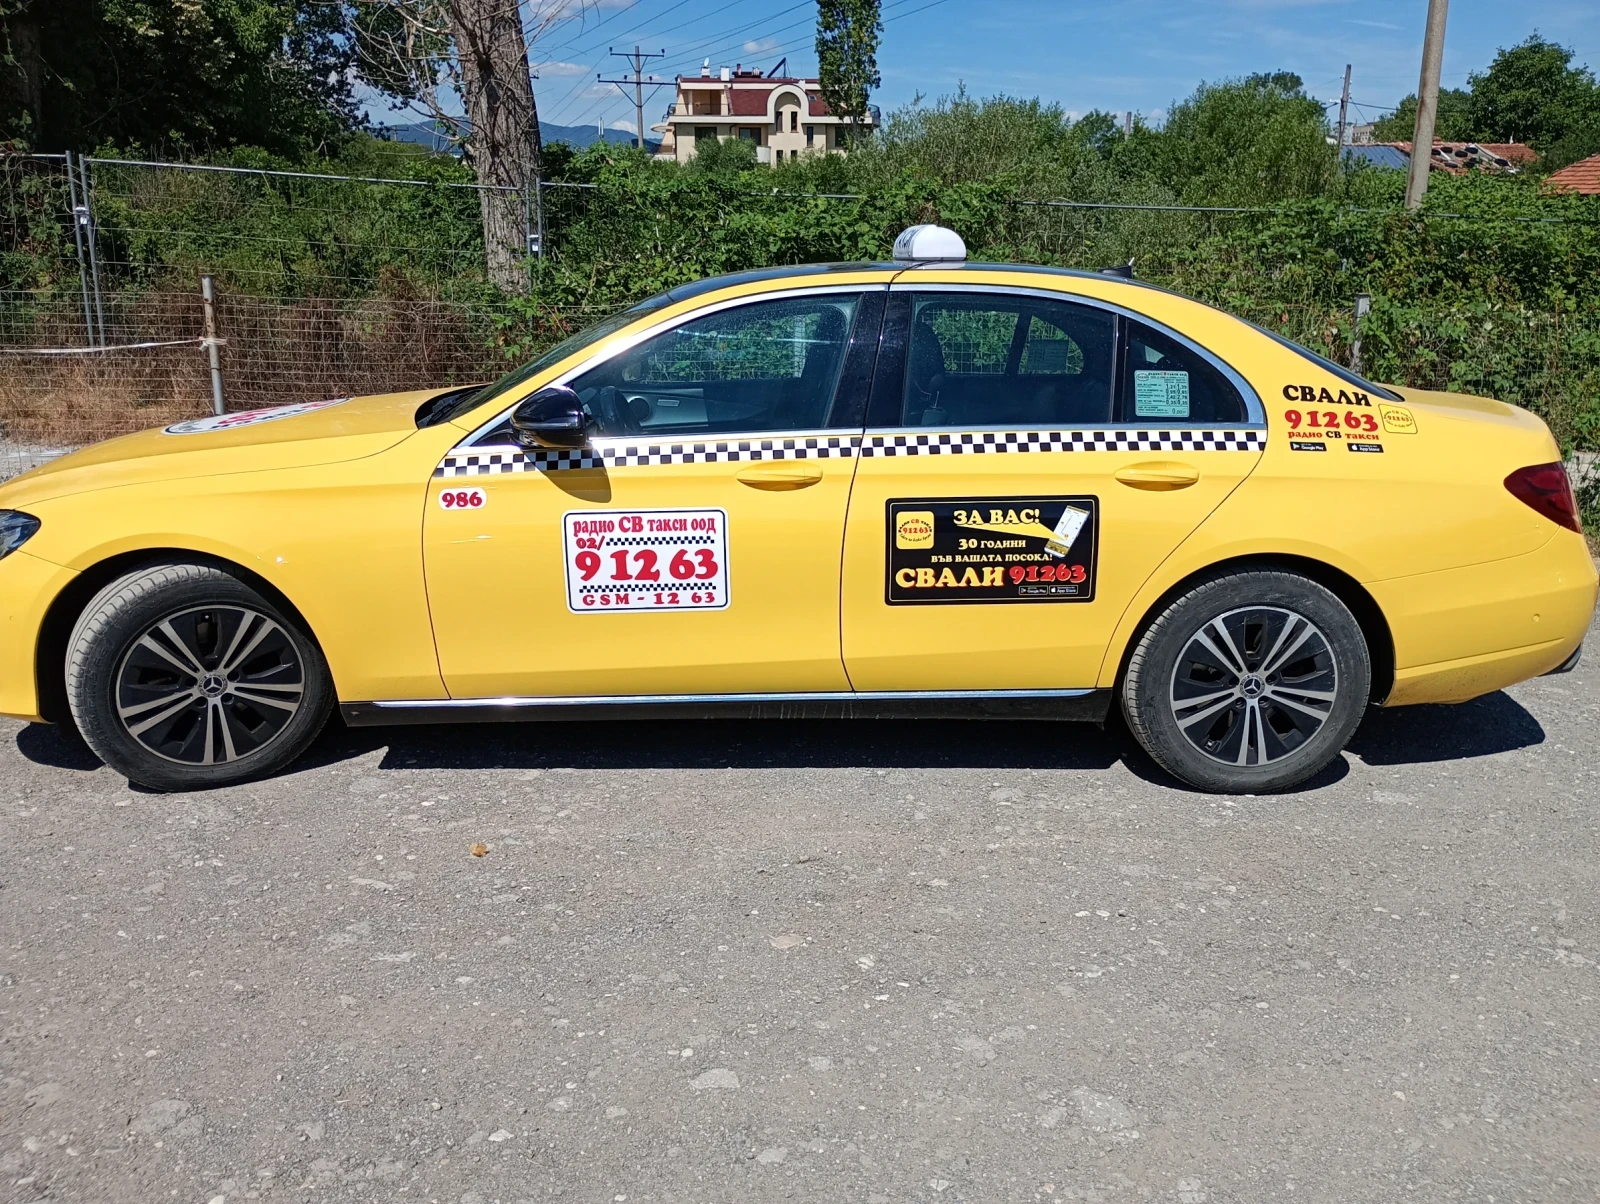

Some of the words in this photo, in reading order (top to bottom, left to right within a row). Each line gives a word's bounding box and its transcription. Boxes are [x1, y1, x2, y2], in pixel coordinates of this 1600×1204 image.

[1282, 384, 1373, 407] СВАЛИ
[1287, 431, 1323, 439] радио
[1325, 430, 1342, 439] СВ
[442, 491, 483, 508] 986
[953, 509, 984, 525] ЗА
[989, 508, 1040, 524] ВАС!
[573, 519, 615, 537] радио
[618, 516, 644, 533] СВ
[647, 518, 688, 532] такси
[691, 517, 717, 534] оод
[576, 535, 605, 551] 02/
[958, 538, 978, 550] 30
[955, 554, 1003, 563] ВАШАТА
[1005, 553, 1053, 562] ПОСОКА!
[895, 566, 1005, 588] СВАЛИ
[1009, 563, 1087, 585] 91263
[582, 593, 630, 606] GSM
[654, 592, 680, 605] 12
[691, 591, 716, 604] 63
